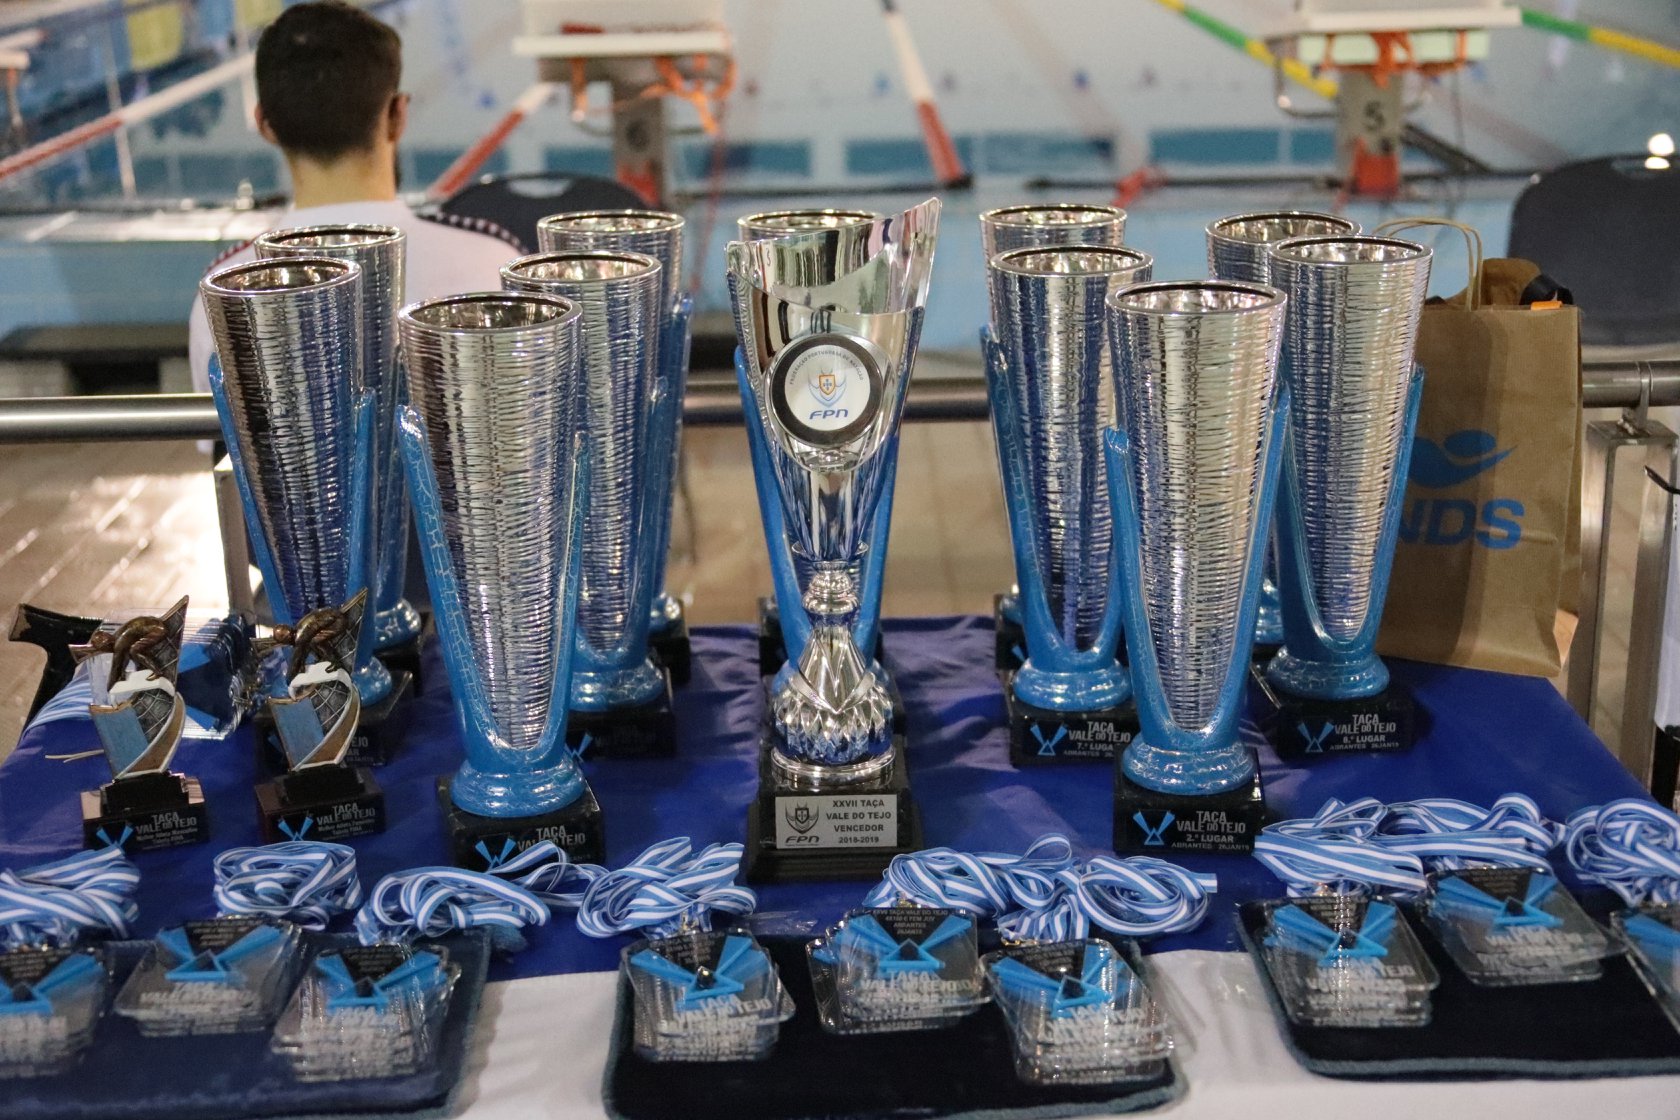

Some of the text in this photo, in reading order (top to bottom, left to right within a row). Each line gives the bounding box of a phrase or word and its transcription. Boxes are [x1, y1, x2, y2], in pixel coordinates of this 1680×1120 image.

[1334, 723, 1360, 735] VALE
[1373, 722, 1396, 733] TEJO
[1068, 730, 1094, 741] VALE
[1107, 732, 1131, 743] TEJO
[1356, 735, 1386, 743] LUGAR
[1089, 743, 1114, 751] LUGA
[832, 799, 885, 809] XXVII TAÇA
[826, 811, 891, 820] VALE DO TEJO
[834, 824, 884, 833] VENCEDOR
[1176, 820, 1246, 834] VALE DO TEJO
[560, 832, 586, 846] TEJO
[1201, 834, 1234, 843] LUGAR
